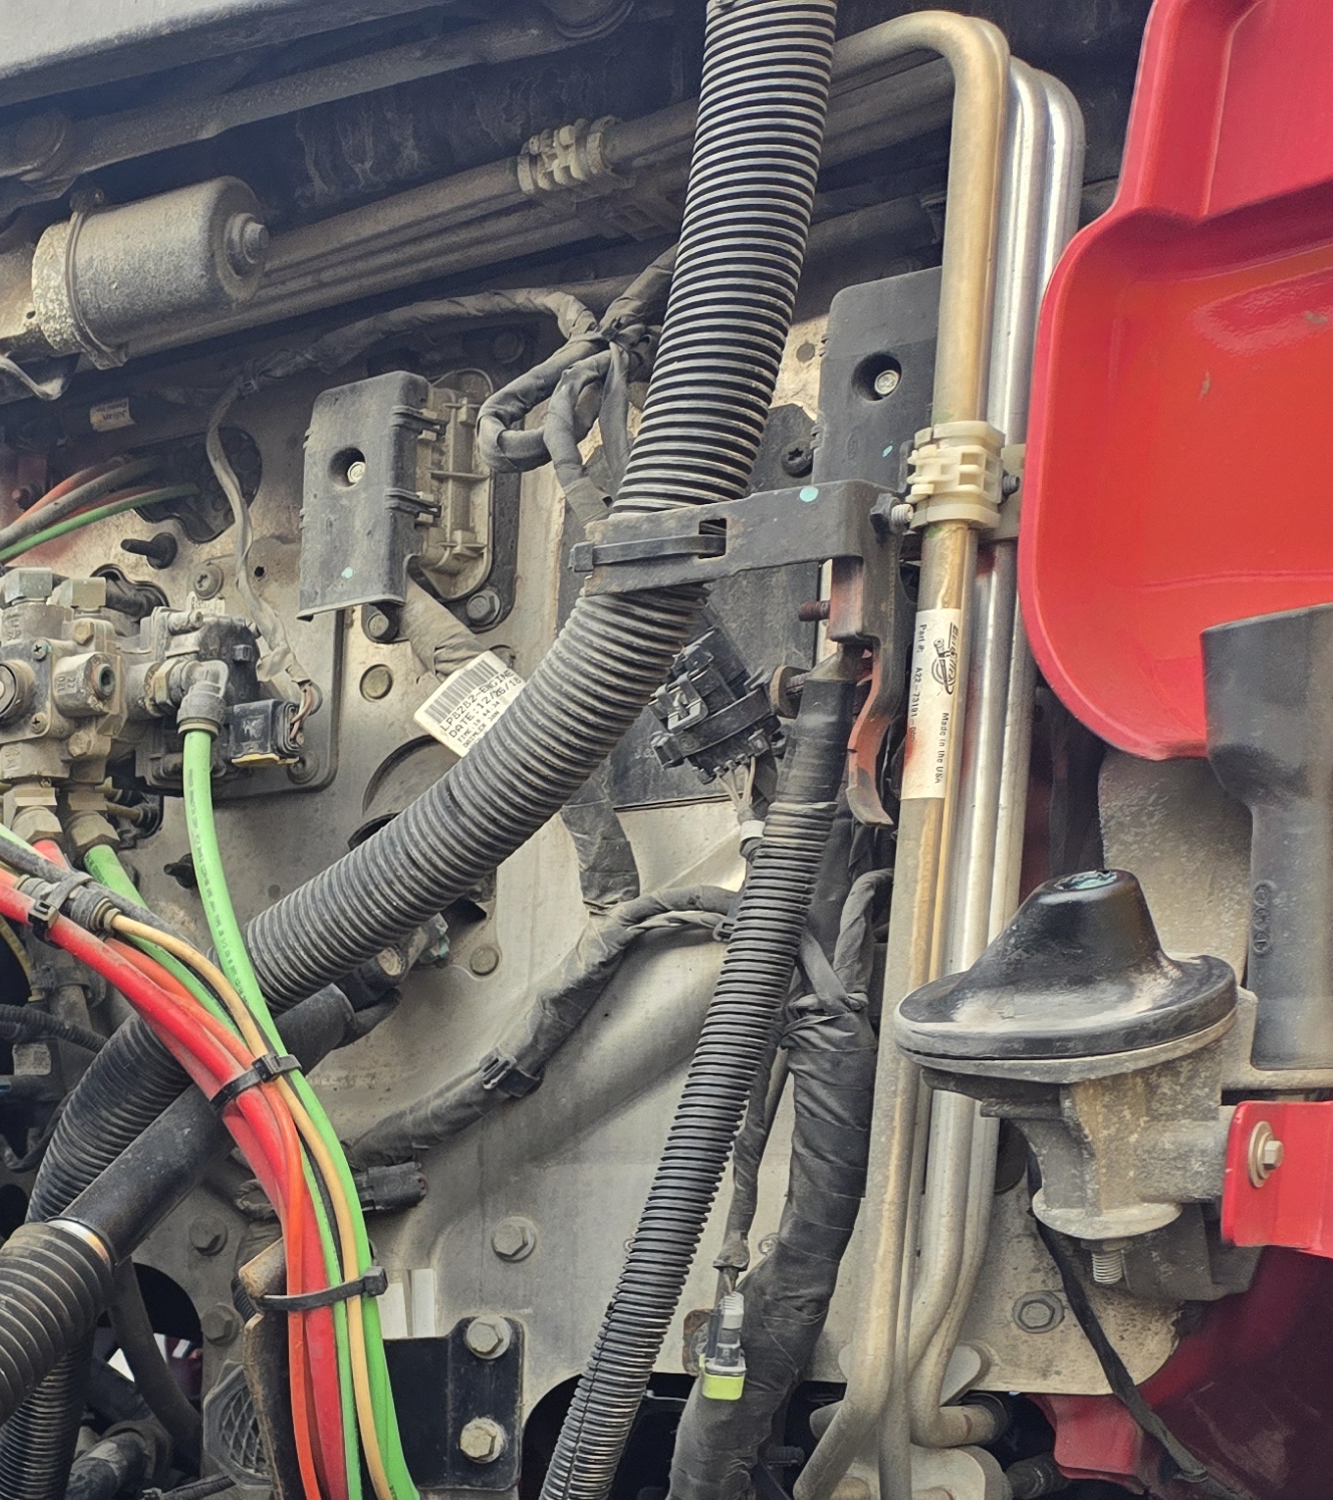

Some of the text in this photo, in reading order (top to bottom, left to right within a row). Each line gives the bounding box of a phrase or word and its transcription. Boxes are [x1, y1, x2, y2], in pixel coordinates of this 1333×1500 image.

[918, 624, 927, 641] Part
[939, 712, 949, 737] Made
[939, 739, 946, 747] in
[937, 750, 945, 764] the
